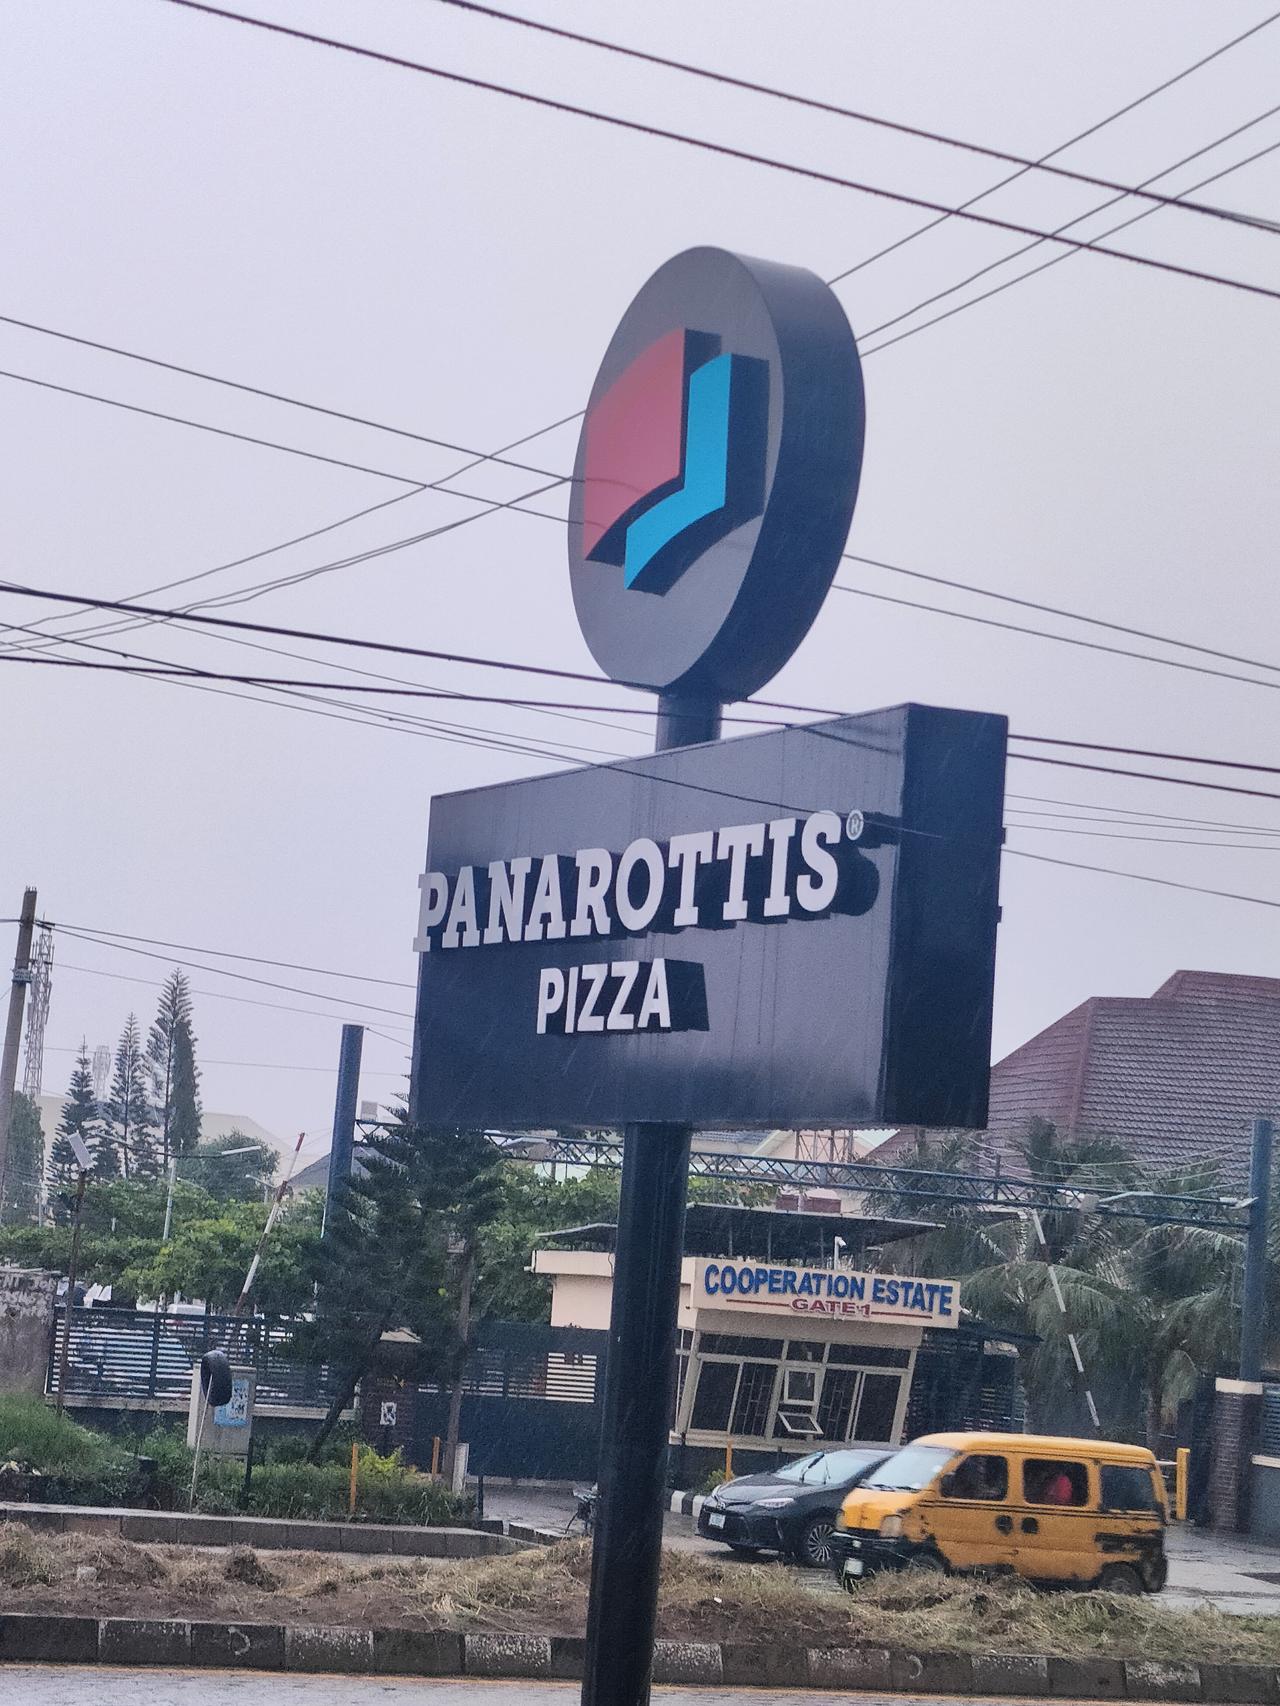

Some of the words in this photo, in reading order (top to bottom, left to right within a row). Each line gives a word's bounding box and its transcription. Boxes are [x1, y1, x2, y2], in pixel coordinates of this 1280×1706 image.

[536, 958, 671, 1034] PIZZA
[704, 1264, 864, 1300] COOPERATION
[872, 1279, 953, 1315] ESTATE
[791, 1298, 856, 1314] GATE
